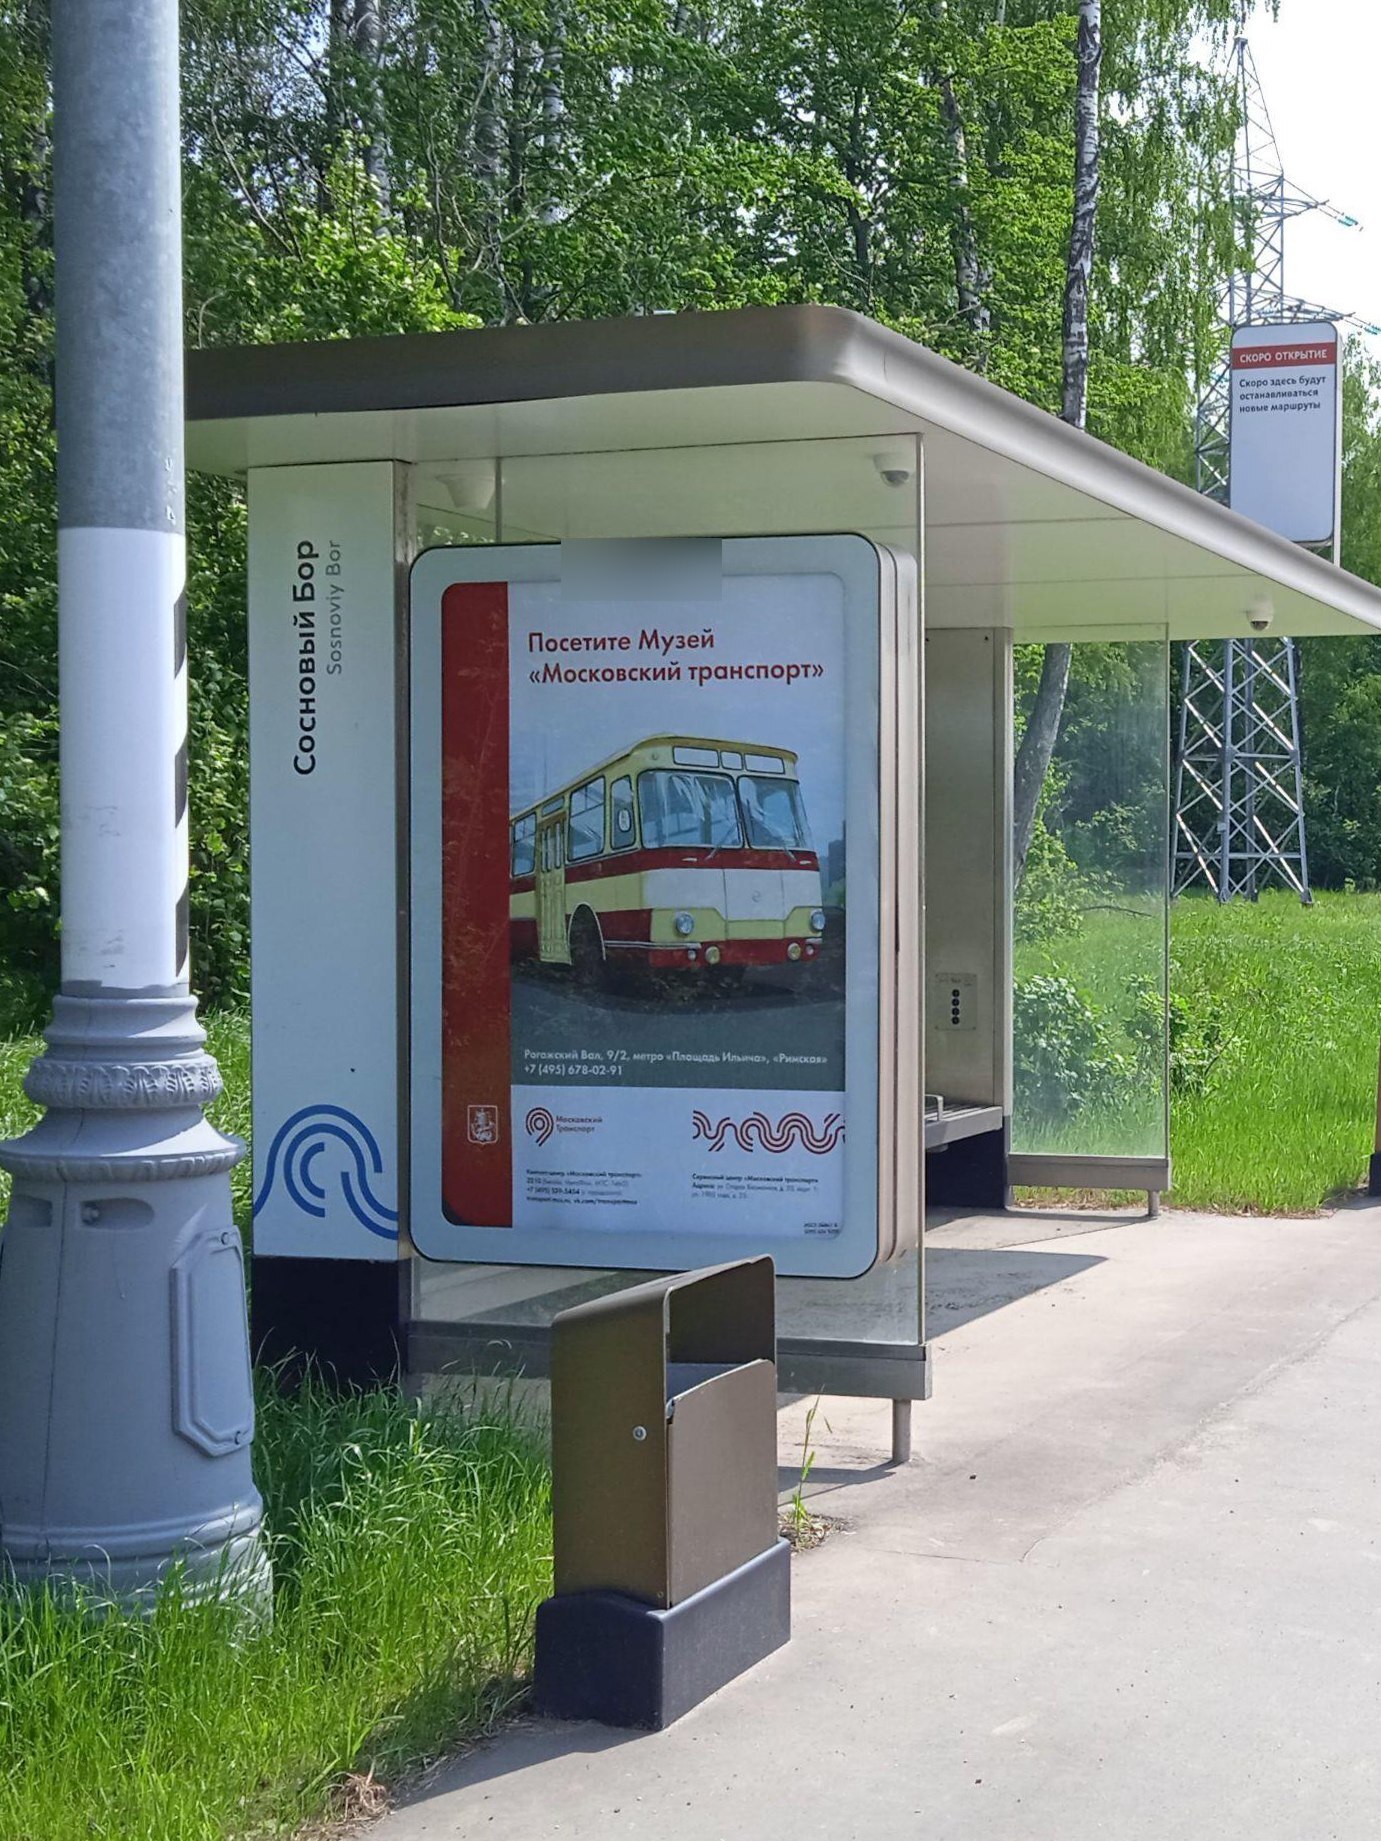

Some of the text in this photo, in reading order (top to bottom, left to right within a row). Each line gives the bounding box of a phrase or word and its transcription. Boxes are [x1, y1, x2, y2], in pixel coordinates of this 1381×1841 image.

[1239, 349, 1328, 364] СКОРО ОТКРЫТИЕ
[1239, 375, 1327, 388] Скоро здесь будут
[1239, 389, 1319, 400] останавливаться
[1239, 401, 1321, 413] новые маршруты
[325, 539, 345, 675] Sosnoviy Bor
[528, 628, 716, 656] Посетите Музей
[293, 539, 320, 775] Сосновый Бор
[529, 661, 825, 687] «Московский транспорт»
[633, 1052, 664, 1064] метро
[524, 1062, 623, 1077] +7 (495) 678-02-91
